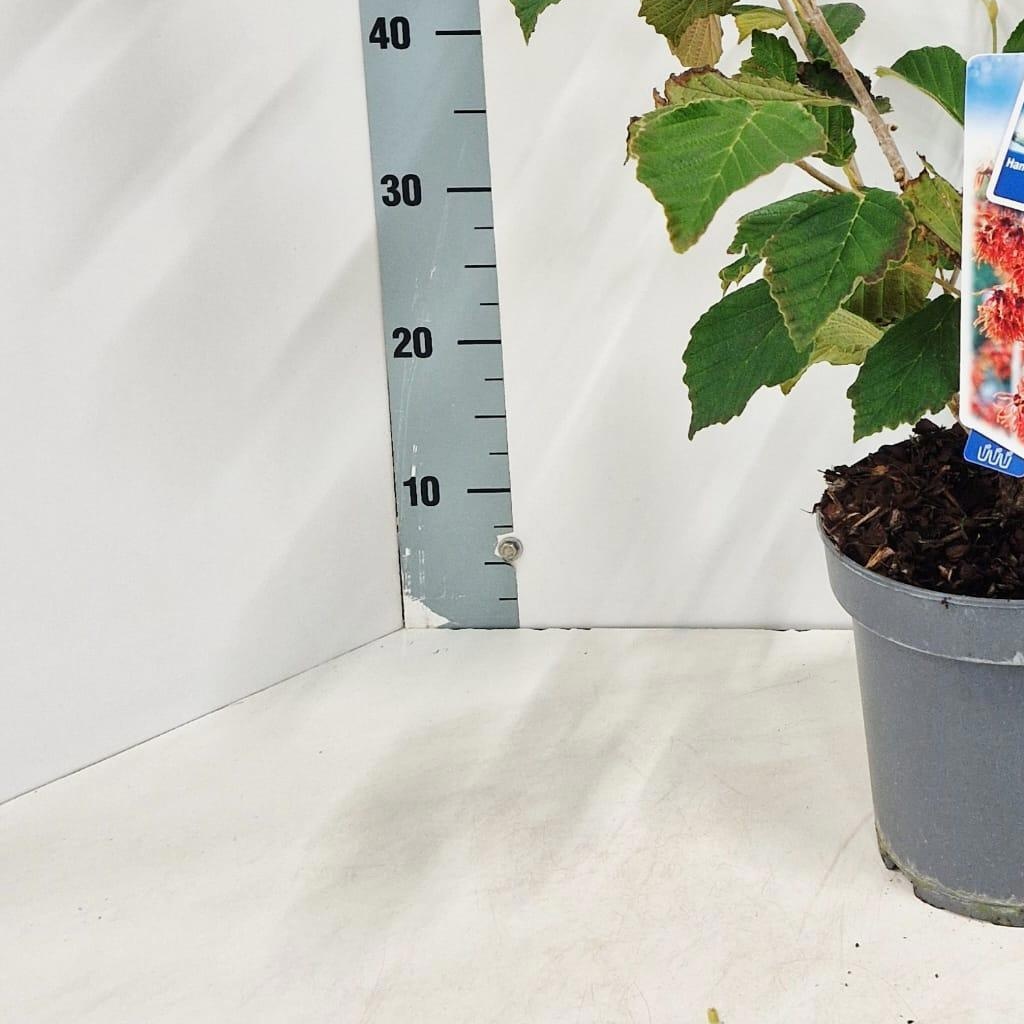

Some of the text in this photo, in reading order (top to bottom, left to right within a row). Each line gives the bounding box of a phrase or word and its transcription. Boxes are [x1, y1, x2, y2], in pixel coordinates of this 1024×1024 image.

[369, 16, 411, 50] 40
[380, 174, 422, 207] 30
[392, 326, 433, 358] 20
[403, 476, 441, 507] 10
